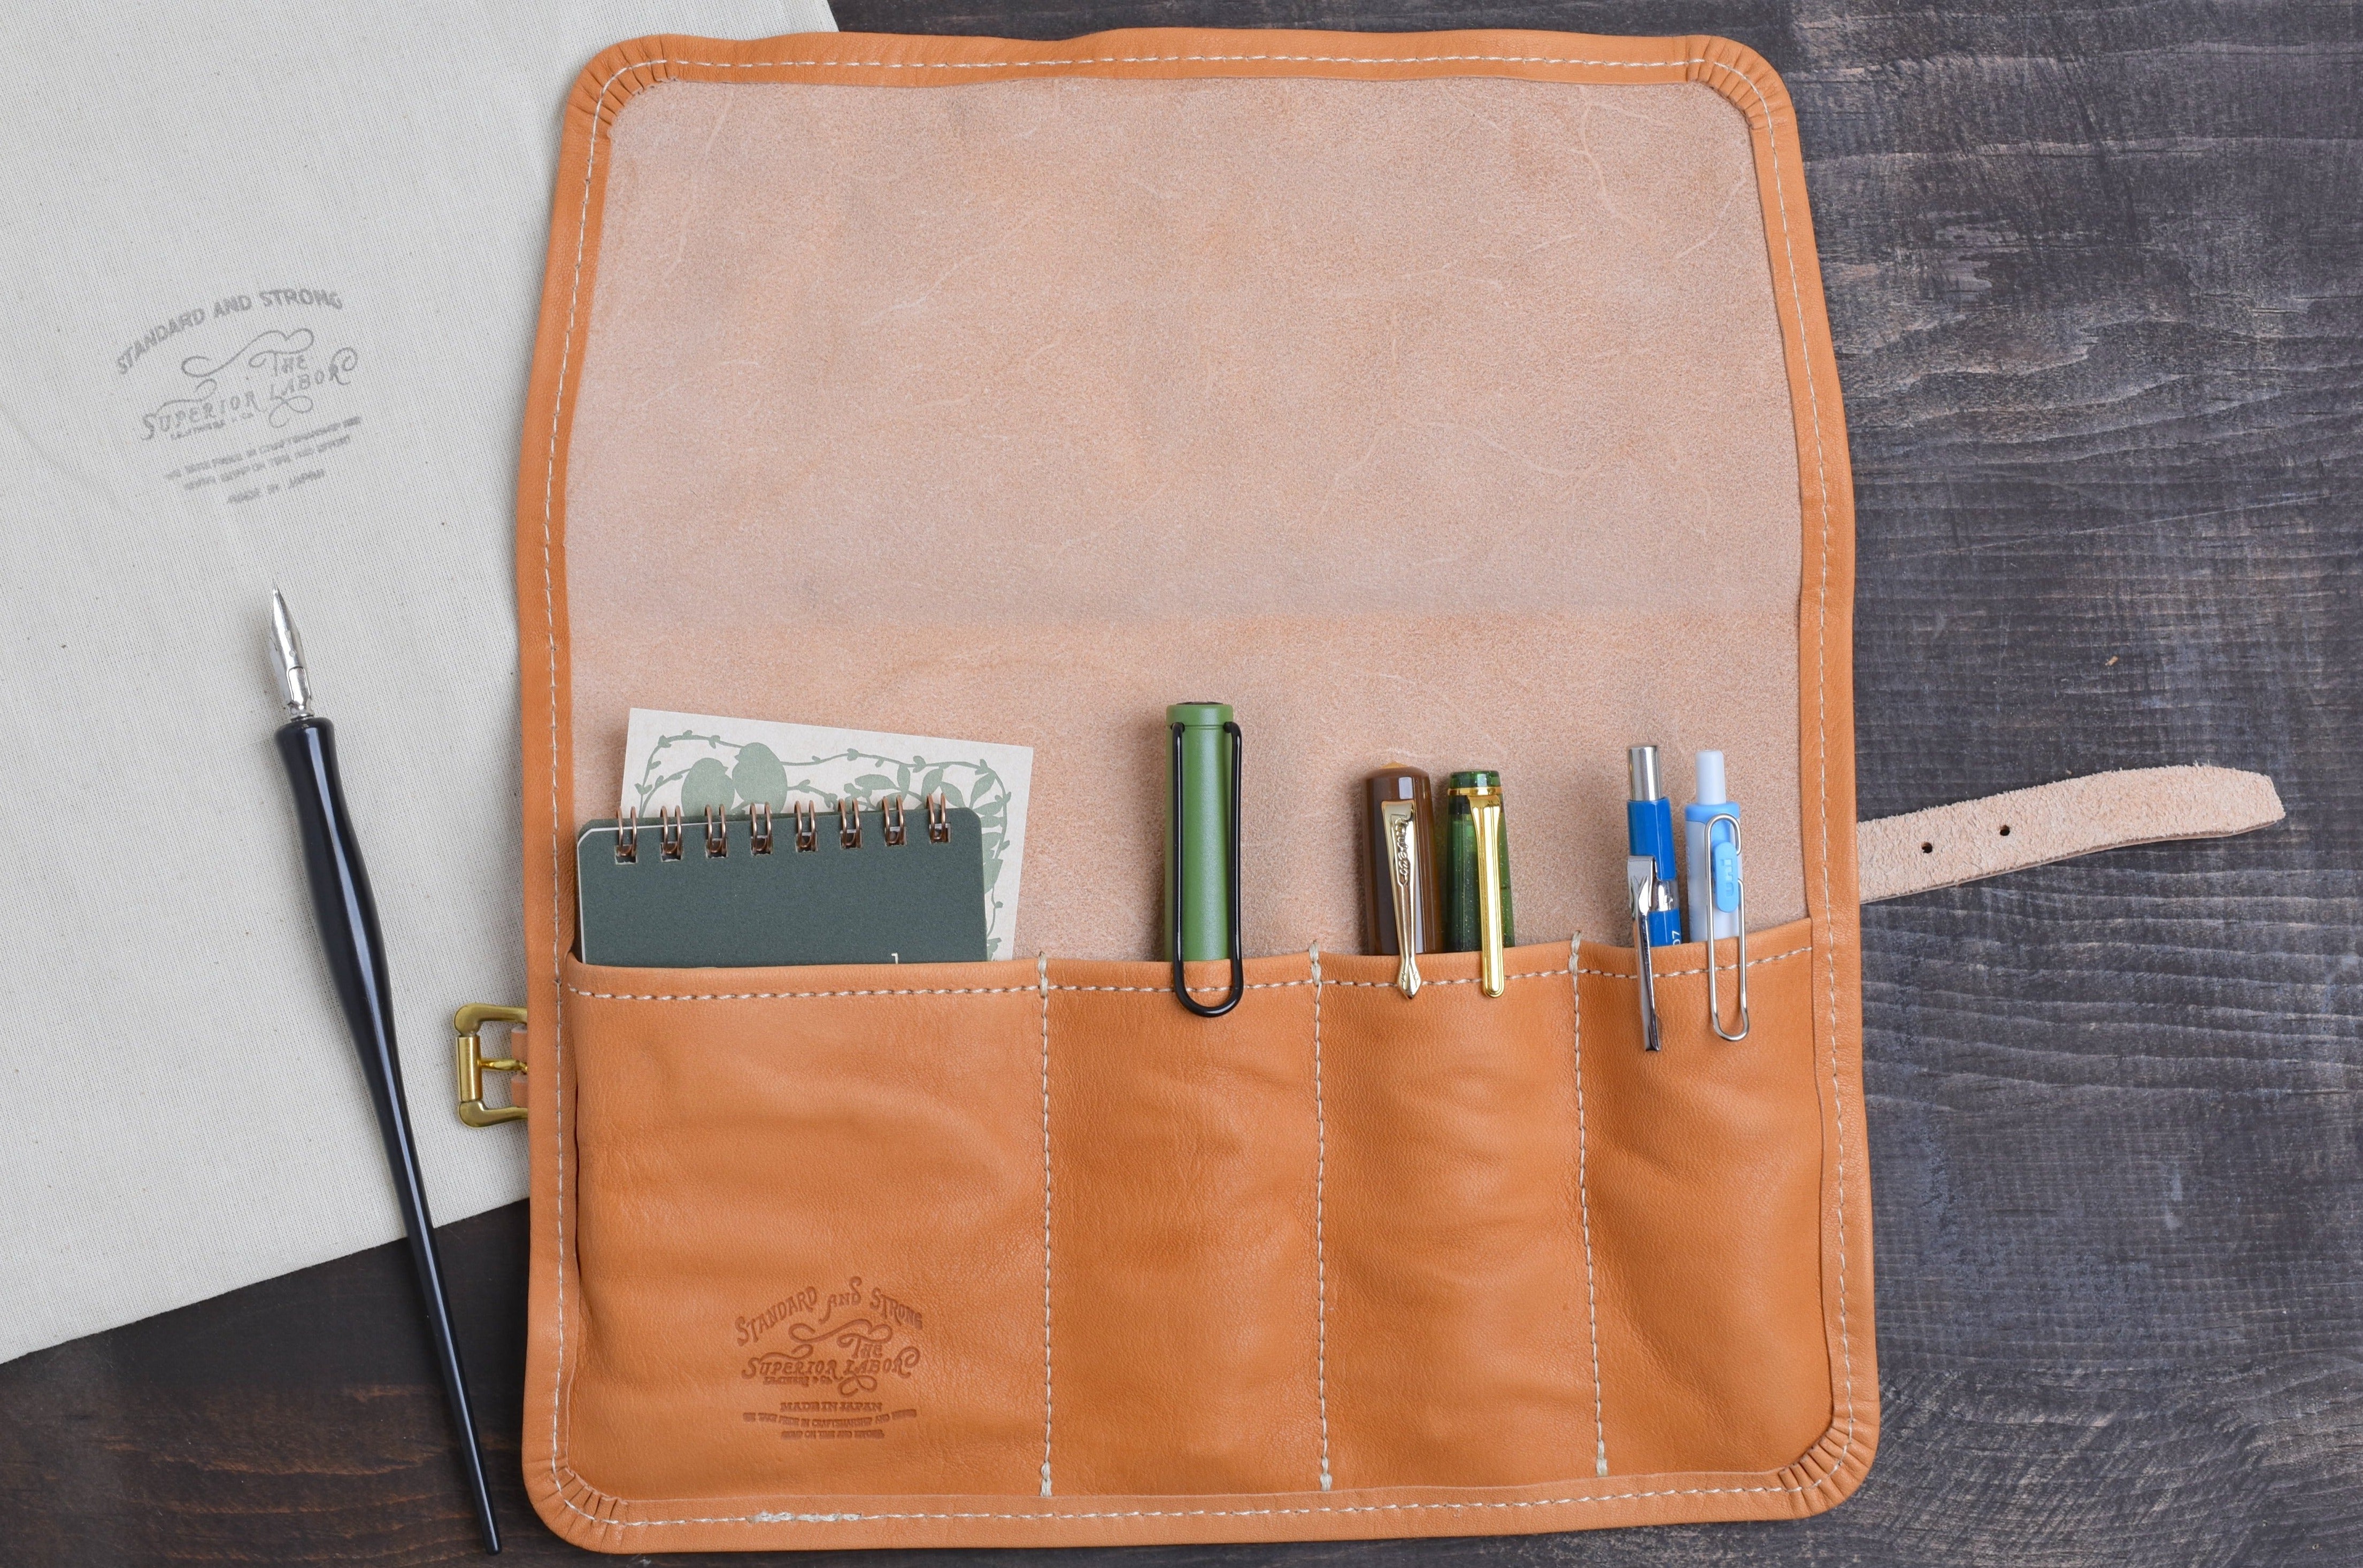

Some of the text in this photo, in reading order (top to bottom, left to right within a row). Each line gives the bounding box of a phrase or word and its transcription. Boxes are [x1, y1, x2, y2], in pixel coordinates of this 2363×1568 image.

[117, 288, 343, 375] STANDARD AND STRONG
[141, 388, 267, 442] SUPERIOR
[269, 347, 358, 403] LABOR
[1720, 859, 1734, 897] uni
[735, 1276, 923, 1346] STANDARD AND STRONG
[741, 1347, 920, 1380] SUPERIOR LABOR
[780, 1401, 883, 1412] MADE IN JAPAN
